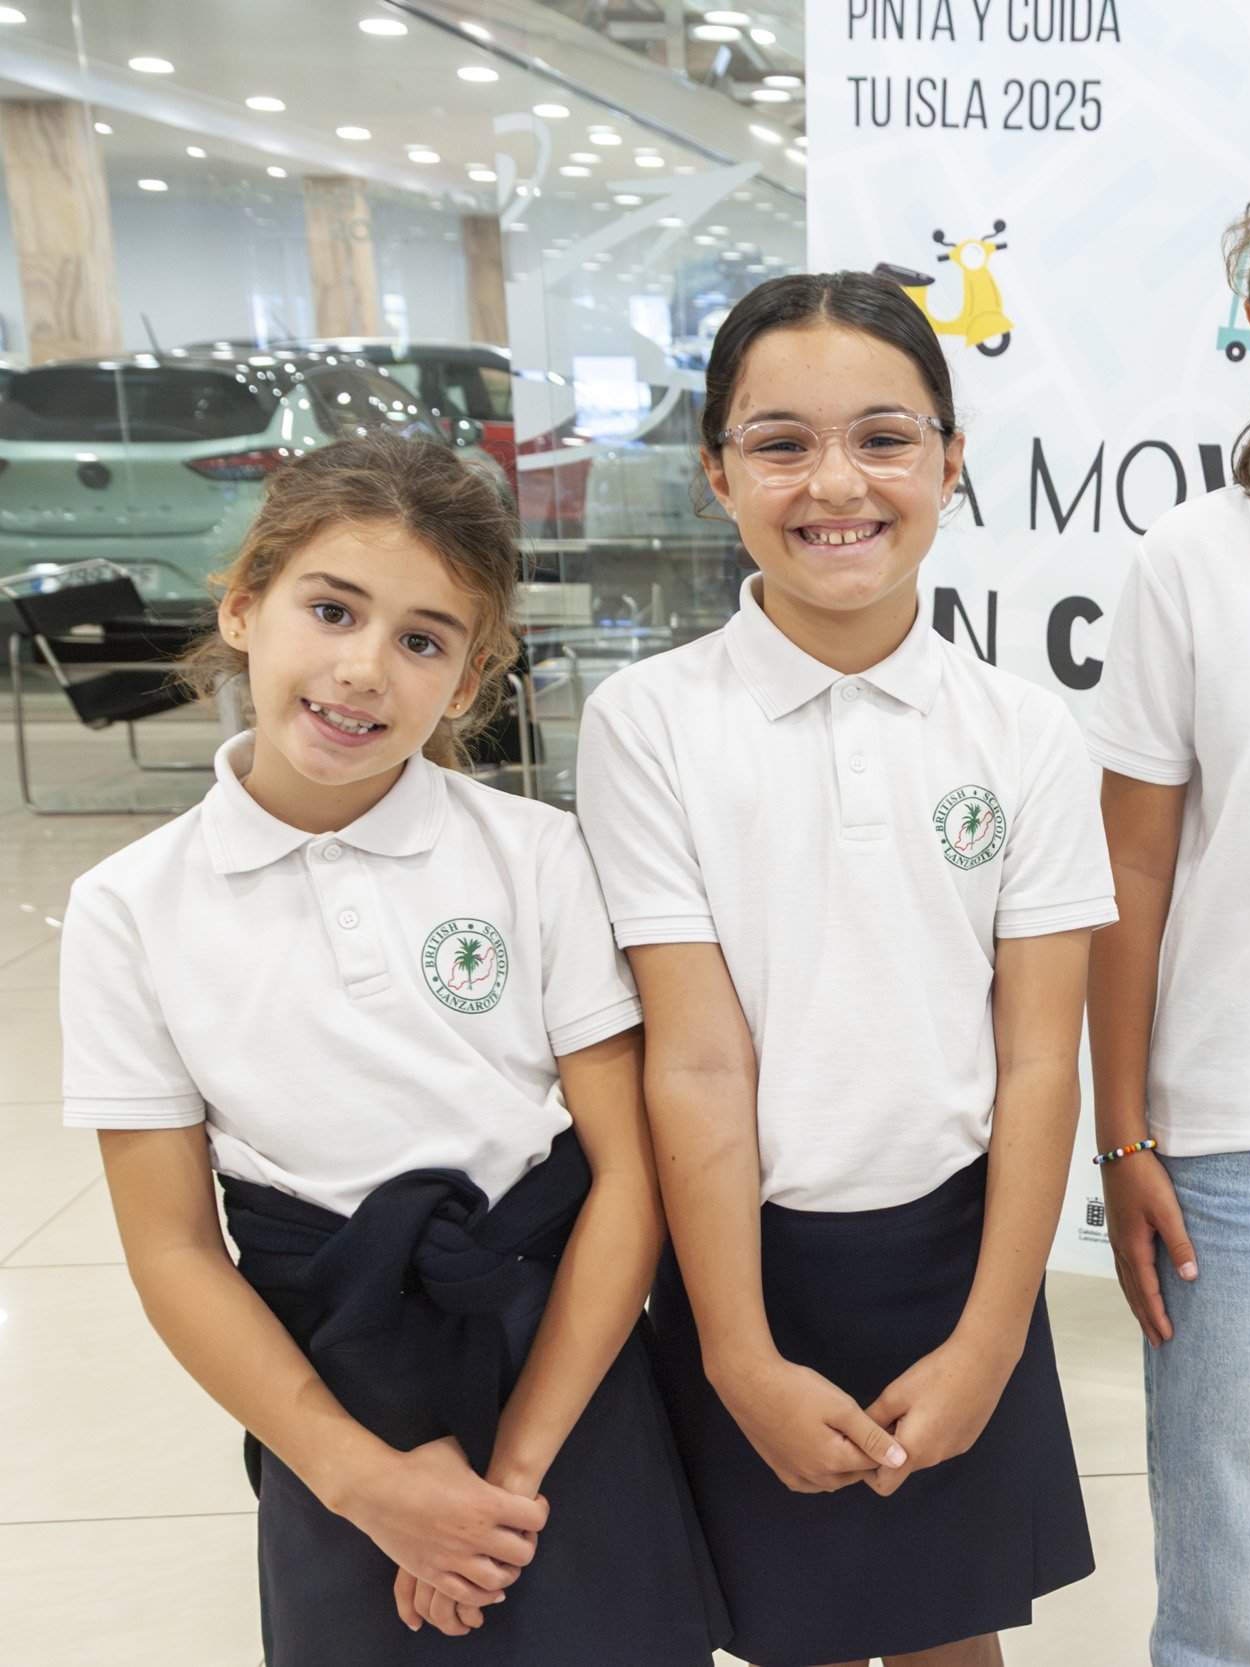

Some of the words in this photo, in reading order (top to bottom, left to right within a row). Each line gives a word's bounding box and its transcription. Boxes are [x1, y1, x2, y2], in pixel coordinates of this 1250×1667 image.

[1007, 0, 1121, 42] CUIDA
[847, 76, 892, 127] TU
[905, 77, 988, 129] ISLA
[1003, 79, 1102, 131] 2025
[935, 790, 966, 832] BRITISH
[425, 922, 459, 968] BRITISH
[482, 925, 506, 976] SCHOOL
